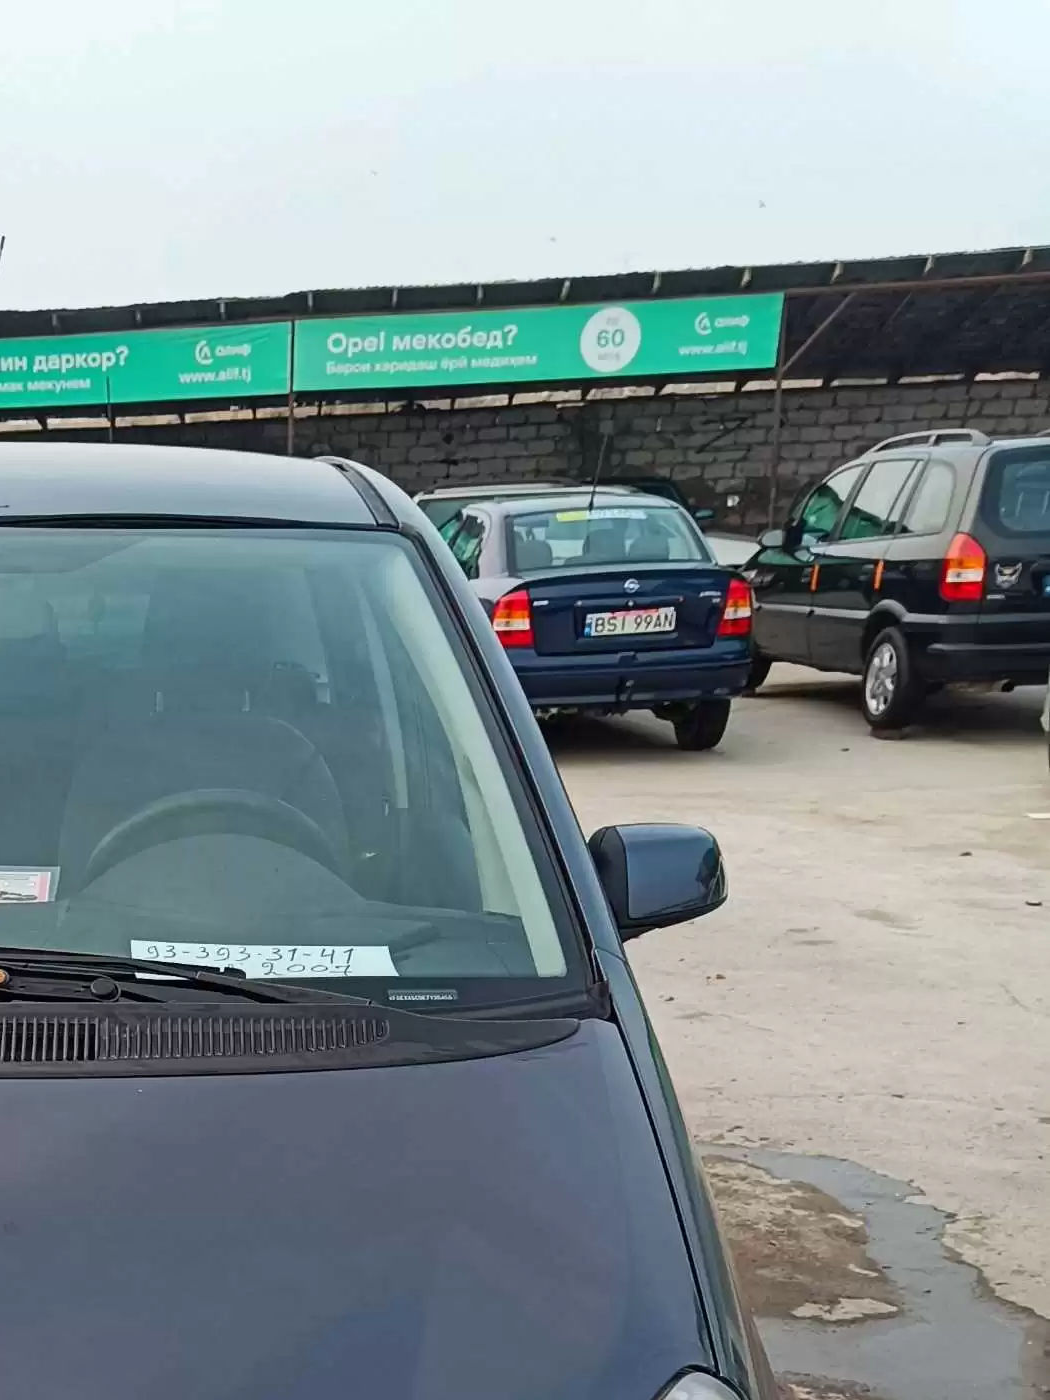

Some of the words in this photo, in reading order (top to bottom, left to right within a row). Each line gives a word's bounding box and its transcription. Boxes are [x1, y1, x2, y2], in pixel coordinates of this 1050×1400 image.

[327, 331, 385, 357] Opel
[392, 324, 518, 351] мекобед?
[597, 328, 625, 348] 60
[33, 346, 128, 373] даркор?
[594, 615, 626, 633] BSI
[147, 946, 355, 964] 93-393-31-41
